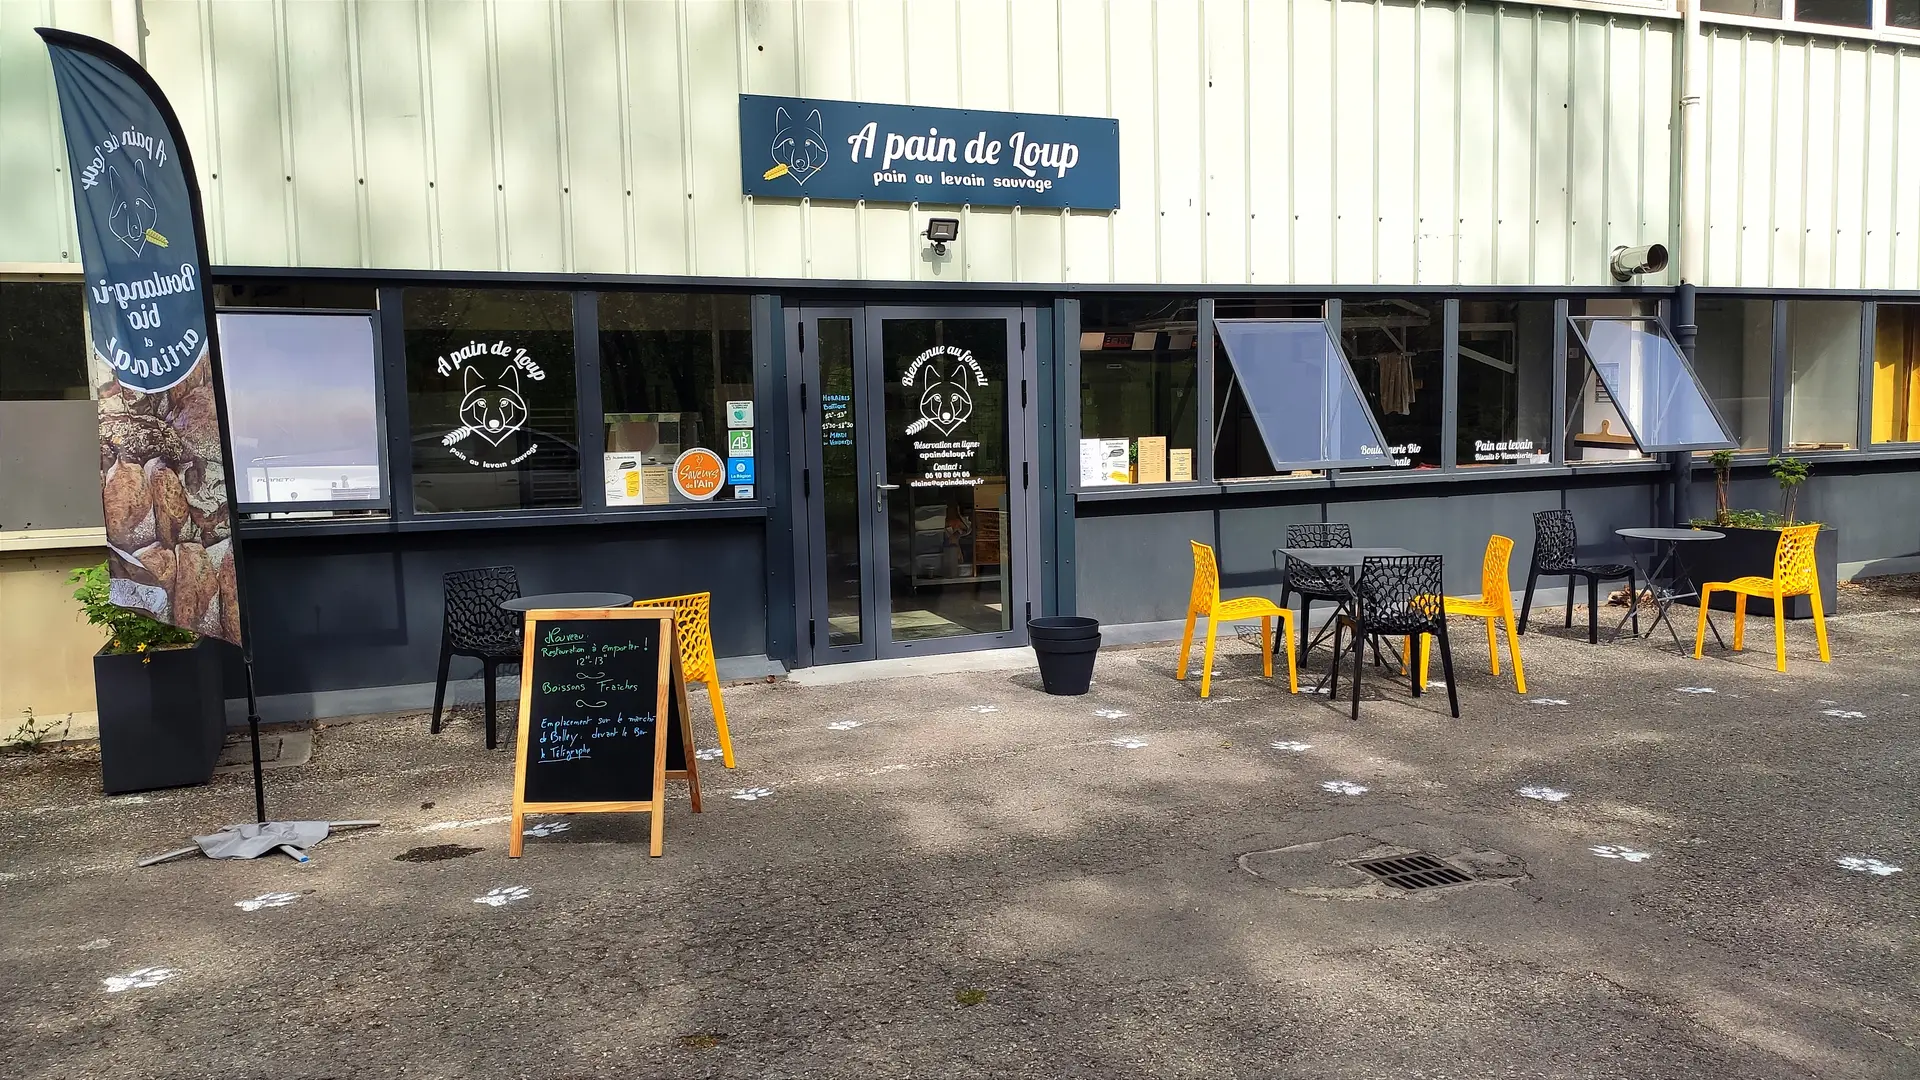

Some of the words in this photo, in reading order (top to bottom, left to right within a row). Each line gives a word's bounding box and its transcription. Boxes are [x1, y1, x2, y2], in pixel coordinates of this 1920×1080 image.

[847, 121, 879, 163] A
[882, 127, 957, 171] pain
[964, 131, 1002, 165] de
[1008, 130, 1080, 179] Loup
[873, 170, 907, 186] pain
[915, 172, 934, 185] au
[940, 172, 985, 188] levain
[993, 176, 1053, 193] sauvage
[437, 355, 452, 377] A
[450, 340, 488, 370] pain
[490, 340, 512, 357] de
[513, 348, 546, 381] Loup
[902, 345, 945, 387] Bienvenue
[947, 345, 962, 357] au
[958, 350, 989, 387] fournil
[731, 436, 749, 449] AB
[913, 441, 952, 450] Réservation
[1407, 442, 1422, 454] Bio
[1475, 440, 1495, 452] Pain
[1495, 442, 1507, 451] au
[1508, 438, 1533, 450] levain
[449, 447, 467, 461] pain
[483, 460, 508, 469] levain
[510, 443, 539, 465] sauvage
[919, 450, 975, 460] apaindeloup.fr
[1474, 452, 1495, 461] Biscuits
[1495, 452, 1501, 460] &
[679, 464, 719, 481] Saveurs
[933, 462, 958, 471] Contact
[693, 480, 714, 489] l'Ain
[541, 644, 585, 658] Restauration
[592, 643, 597, 652] à
[601, 640, 640, 658] emporter
[542, 681, 586, 695] Boissons
[541, 715, 593, 733] Emplacement
[598, 717, 611, 725] sur
[618, 712, 623, 723] le
[628, 711, 657, 723] marché
[539, 731, 547, 743] de
[591, 727, 618, 739] devant
[621, 726, 627, 737] le
[633, 726, 648, 737] Bar
